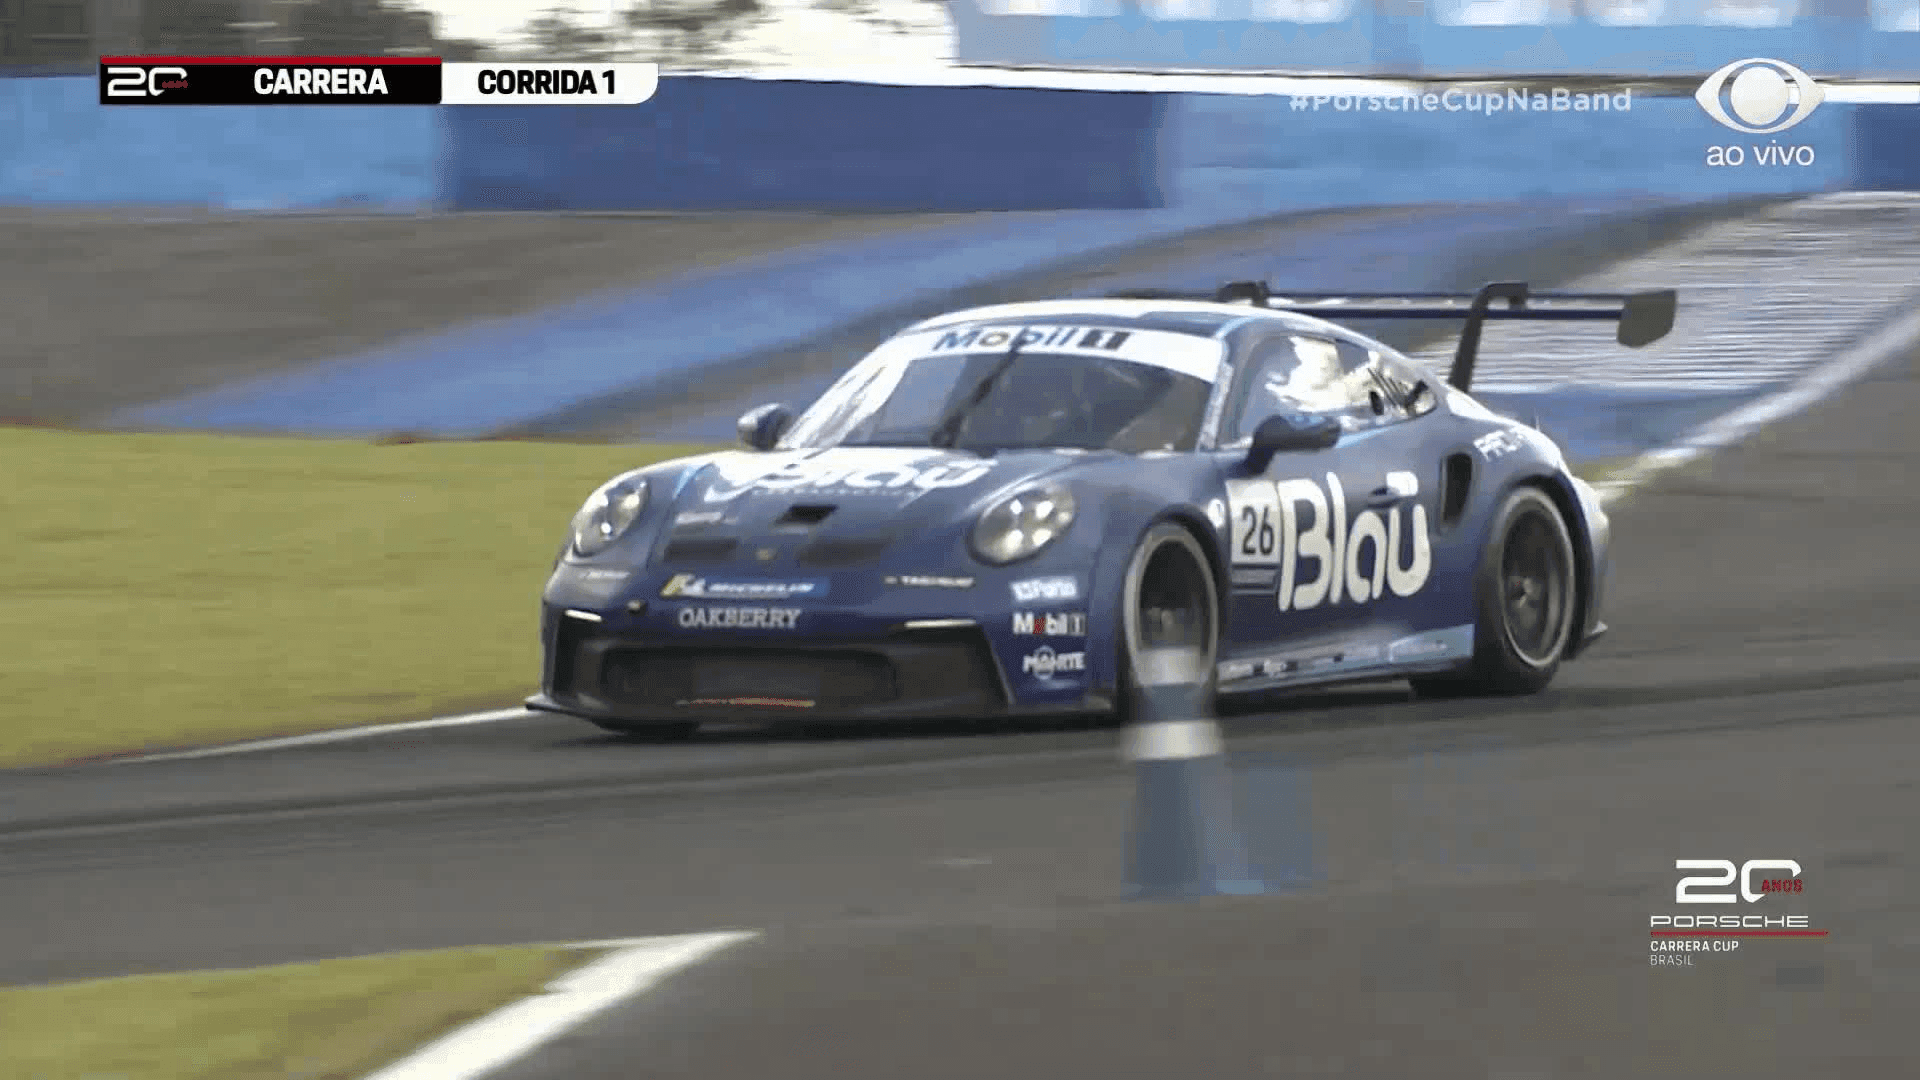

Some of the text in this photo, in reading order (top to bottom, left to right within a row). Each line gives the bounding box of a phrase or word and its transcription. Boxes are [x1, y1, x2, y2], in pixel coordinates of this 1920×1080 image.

[932, 327, 1080, 351] Mobil
[1241, 506, 1275, 556] 26
[678, 607, 801, 628] OAKBERRY
[1013, 612, 1068, 636] Mobil
